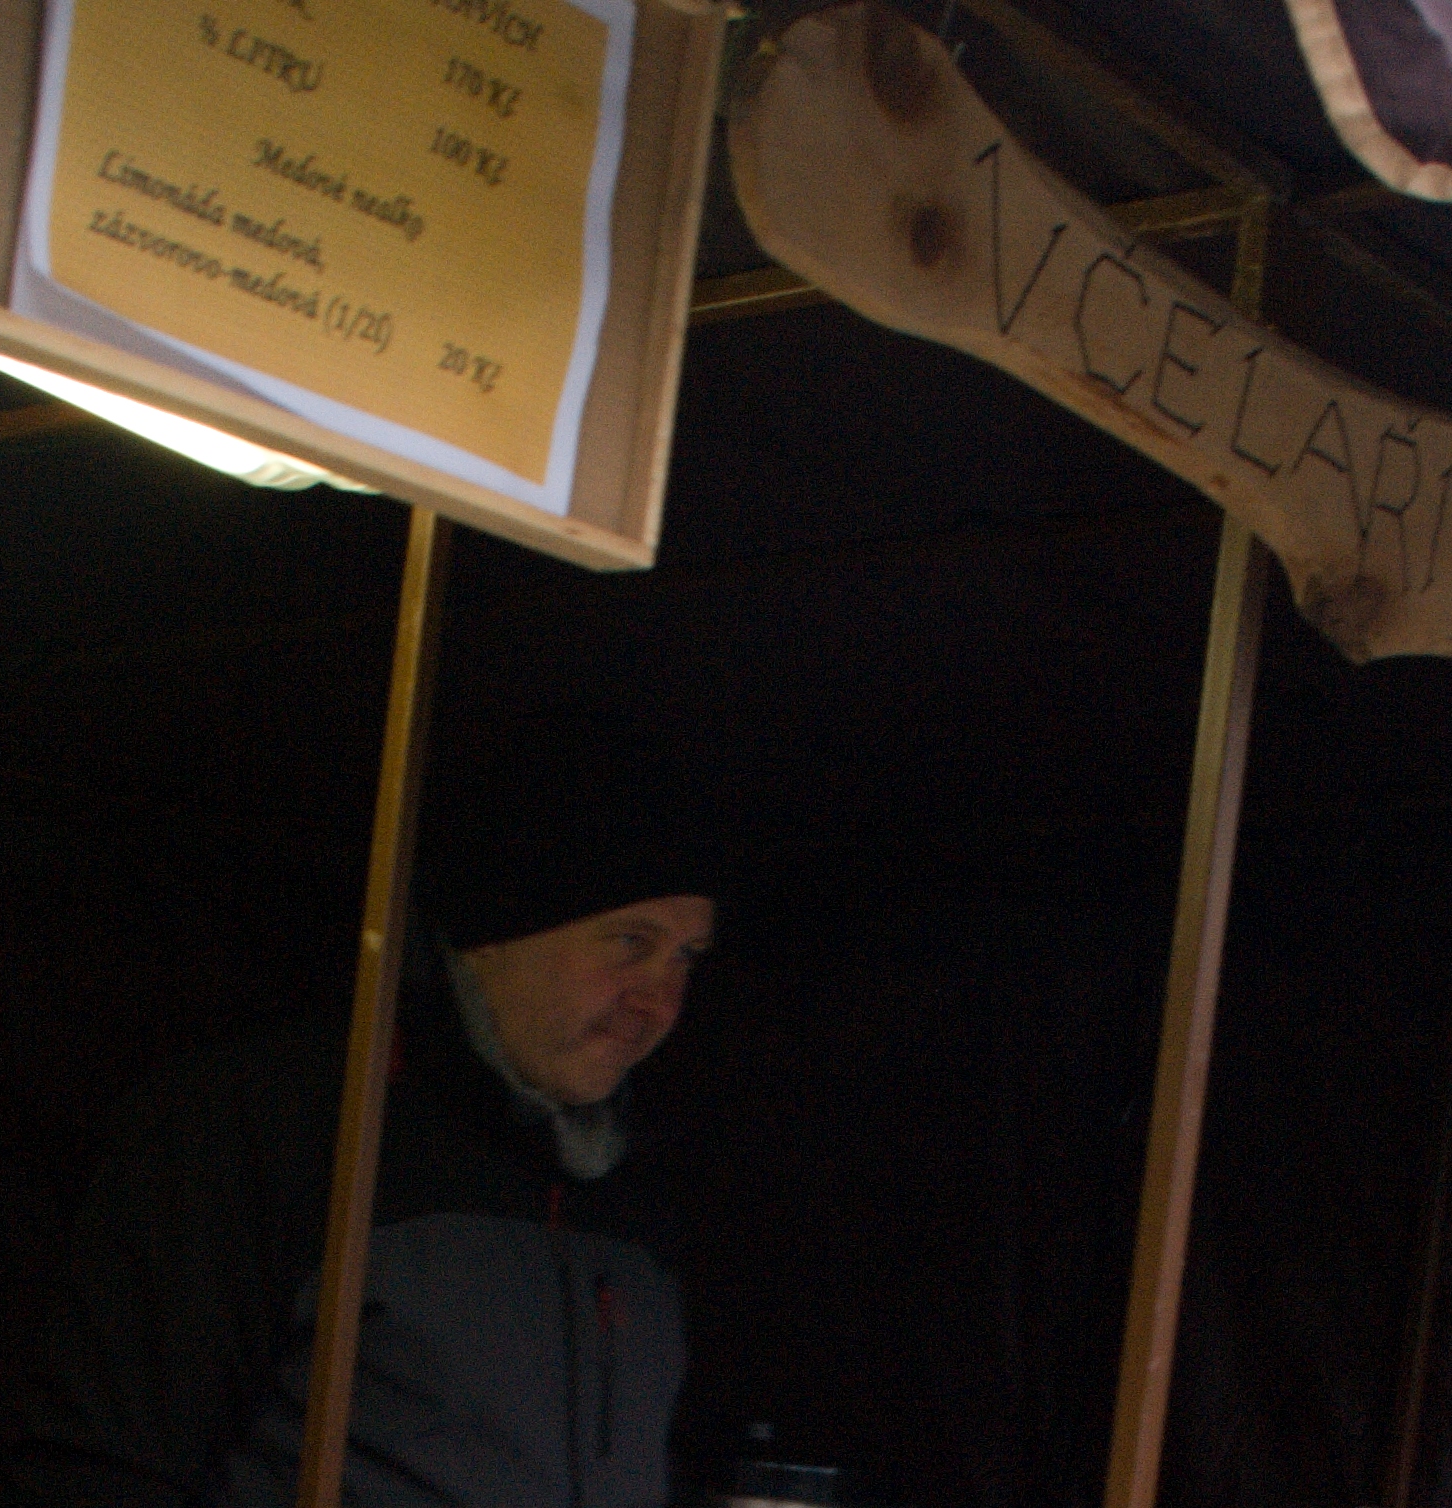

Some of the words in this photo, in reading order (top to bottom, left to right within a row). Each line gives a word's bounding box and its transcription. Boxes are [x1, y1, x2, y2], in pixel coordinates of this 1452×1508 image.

[228, 27, 324, 94] LITRU
[430, 126, 473, 166] 100
[98, 148, 227, 227] Limonáda
[251, 137, 348, 201] Medové
[437, 341, 470, 376] 20
